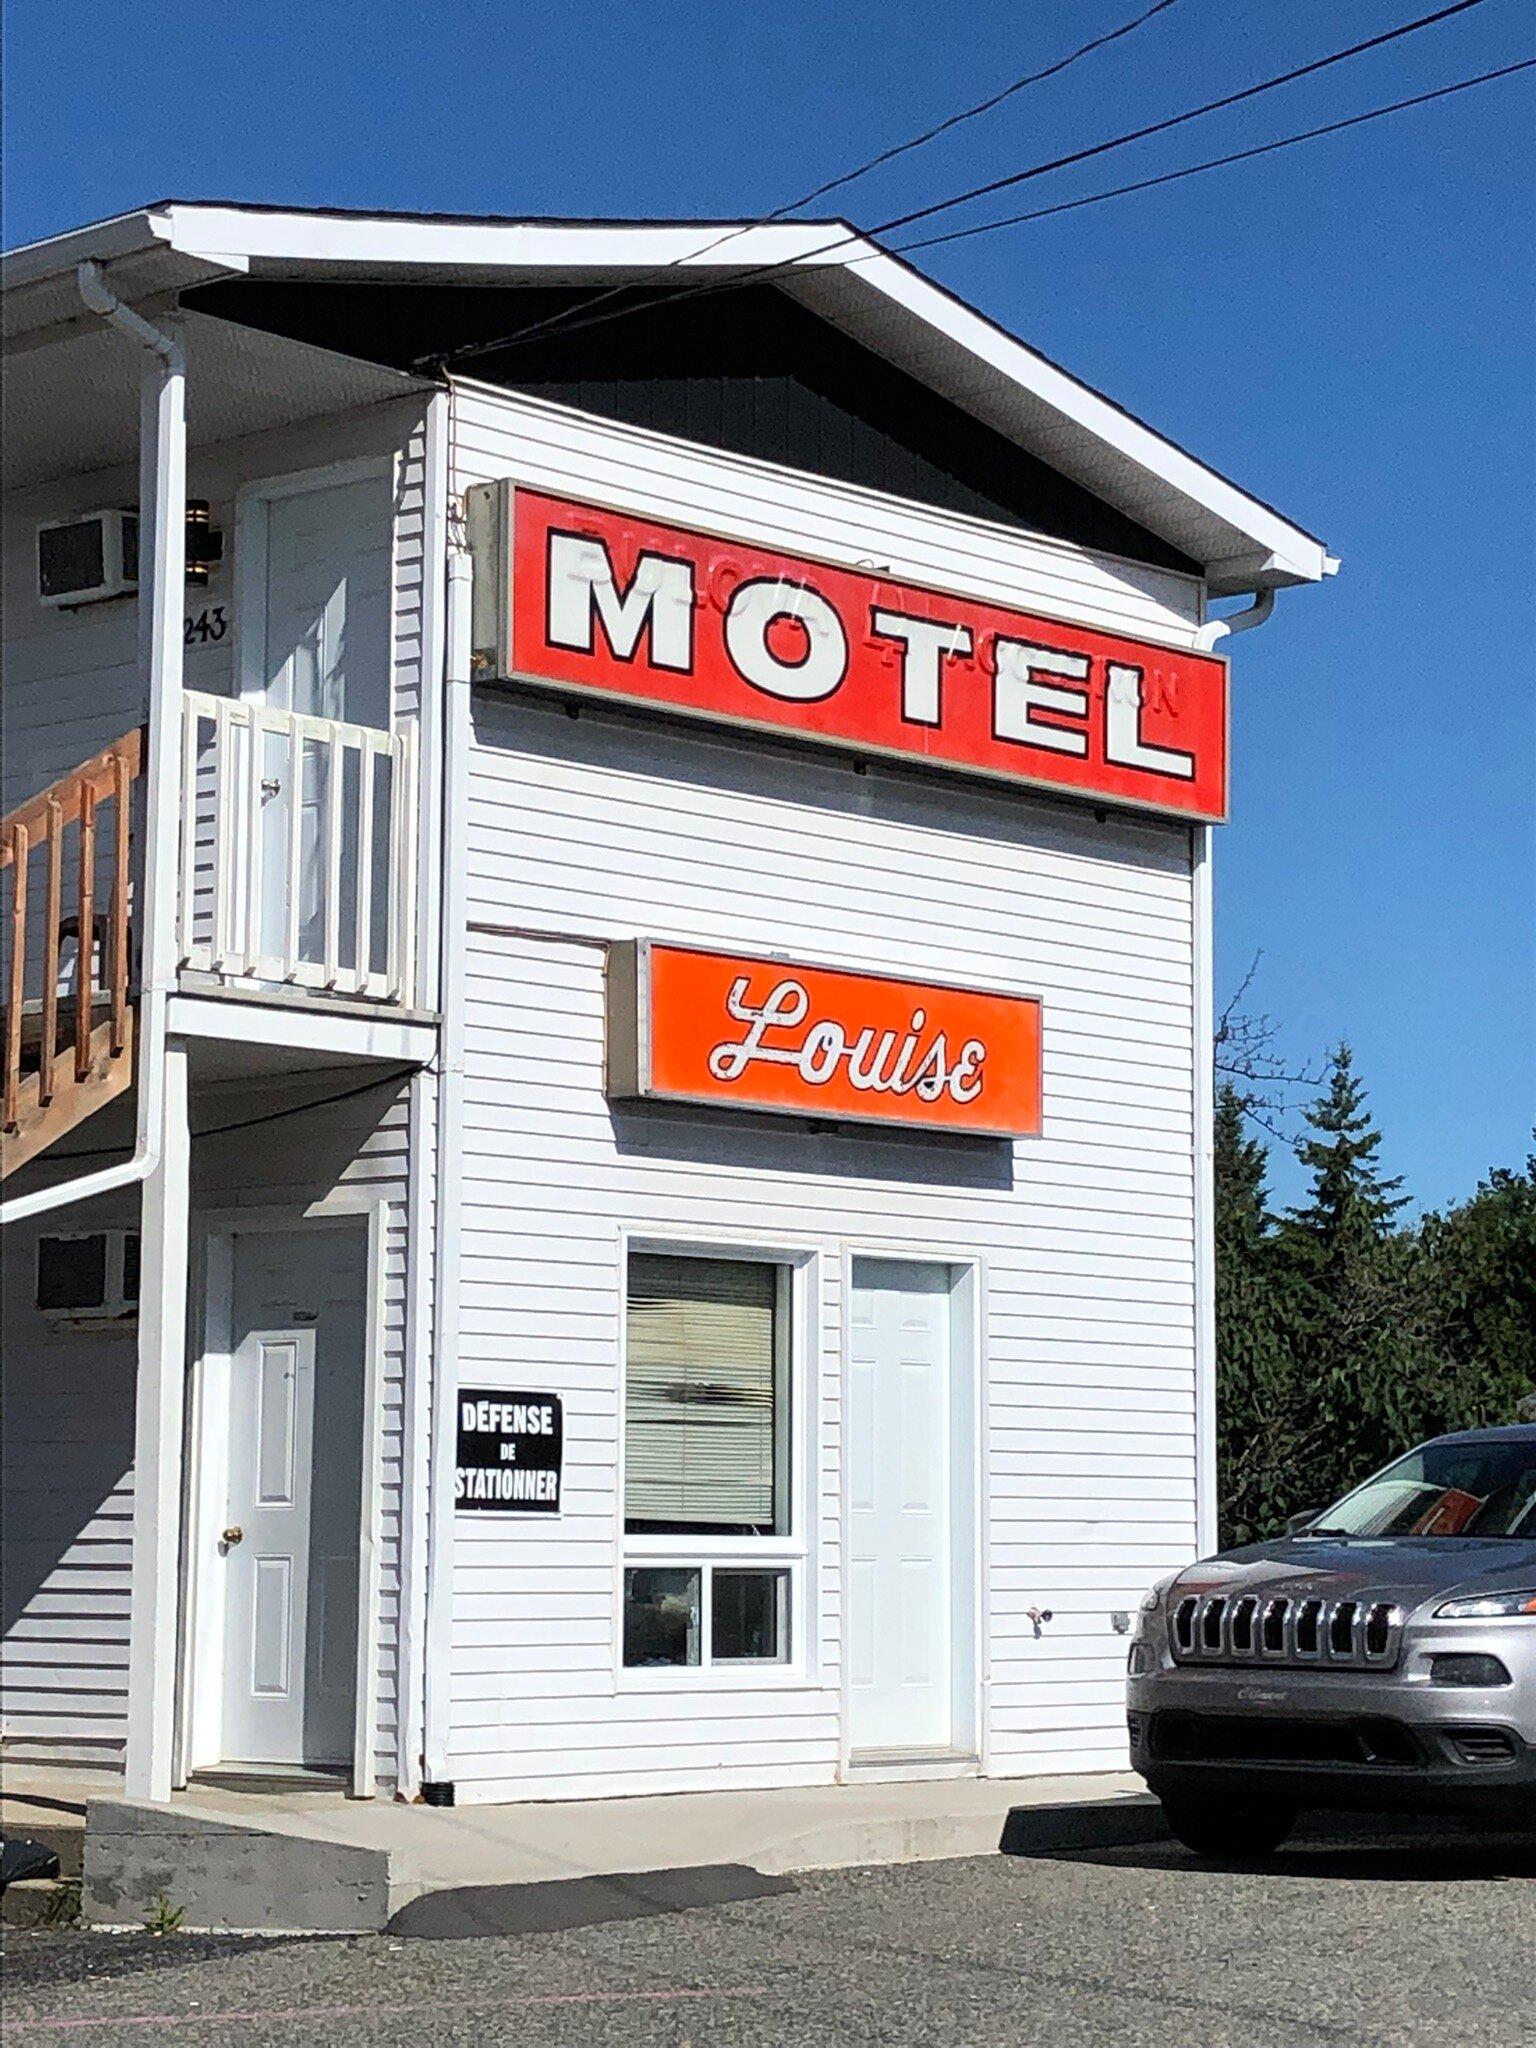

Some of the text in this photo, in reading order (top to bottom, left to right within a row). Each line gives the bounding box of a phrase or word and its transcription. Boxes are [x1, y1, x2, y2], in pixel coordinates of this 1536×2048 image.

[184, 606, 227, 644] 243
[545, 526, 1196, 781] MOTEL
[708, 976, 986, 1103] Louise
[500, 1443, 516, 1460] DE
[455, 1467, 558, 1500] STATIONNER
